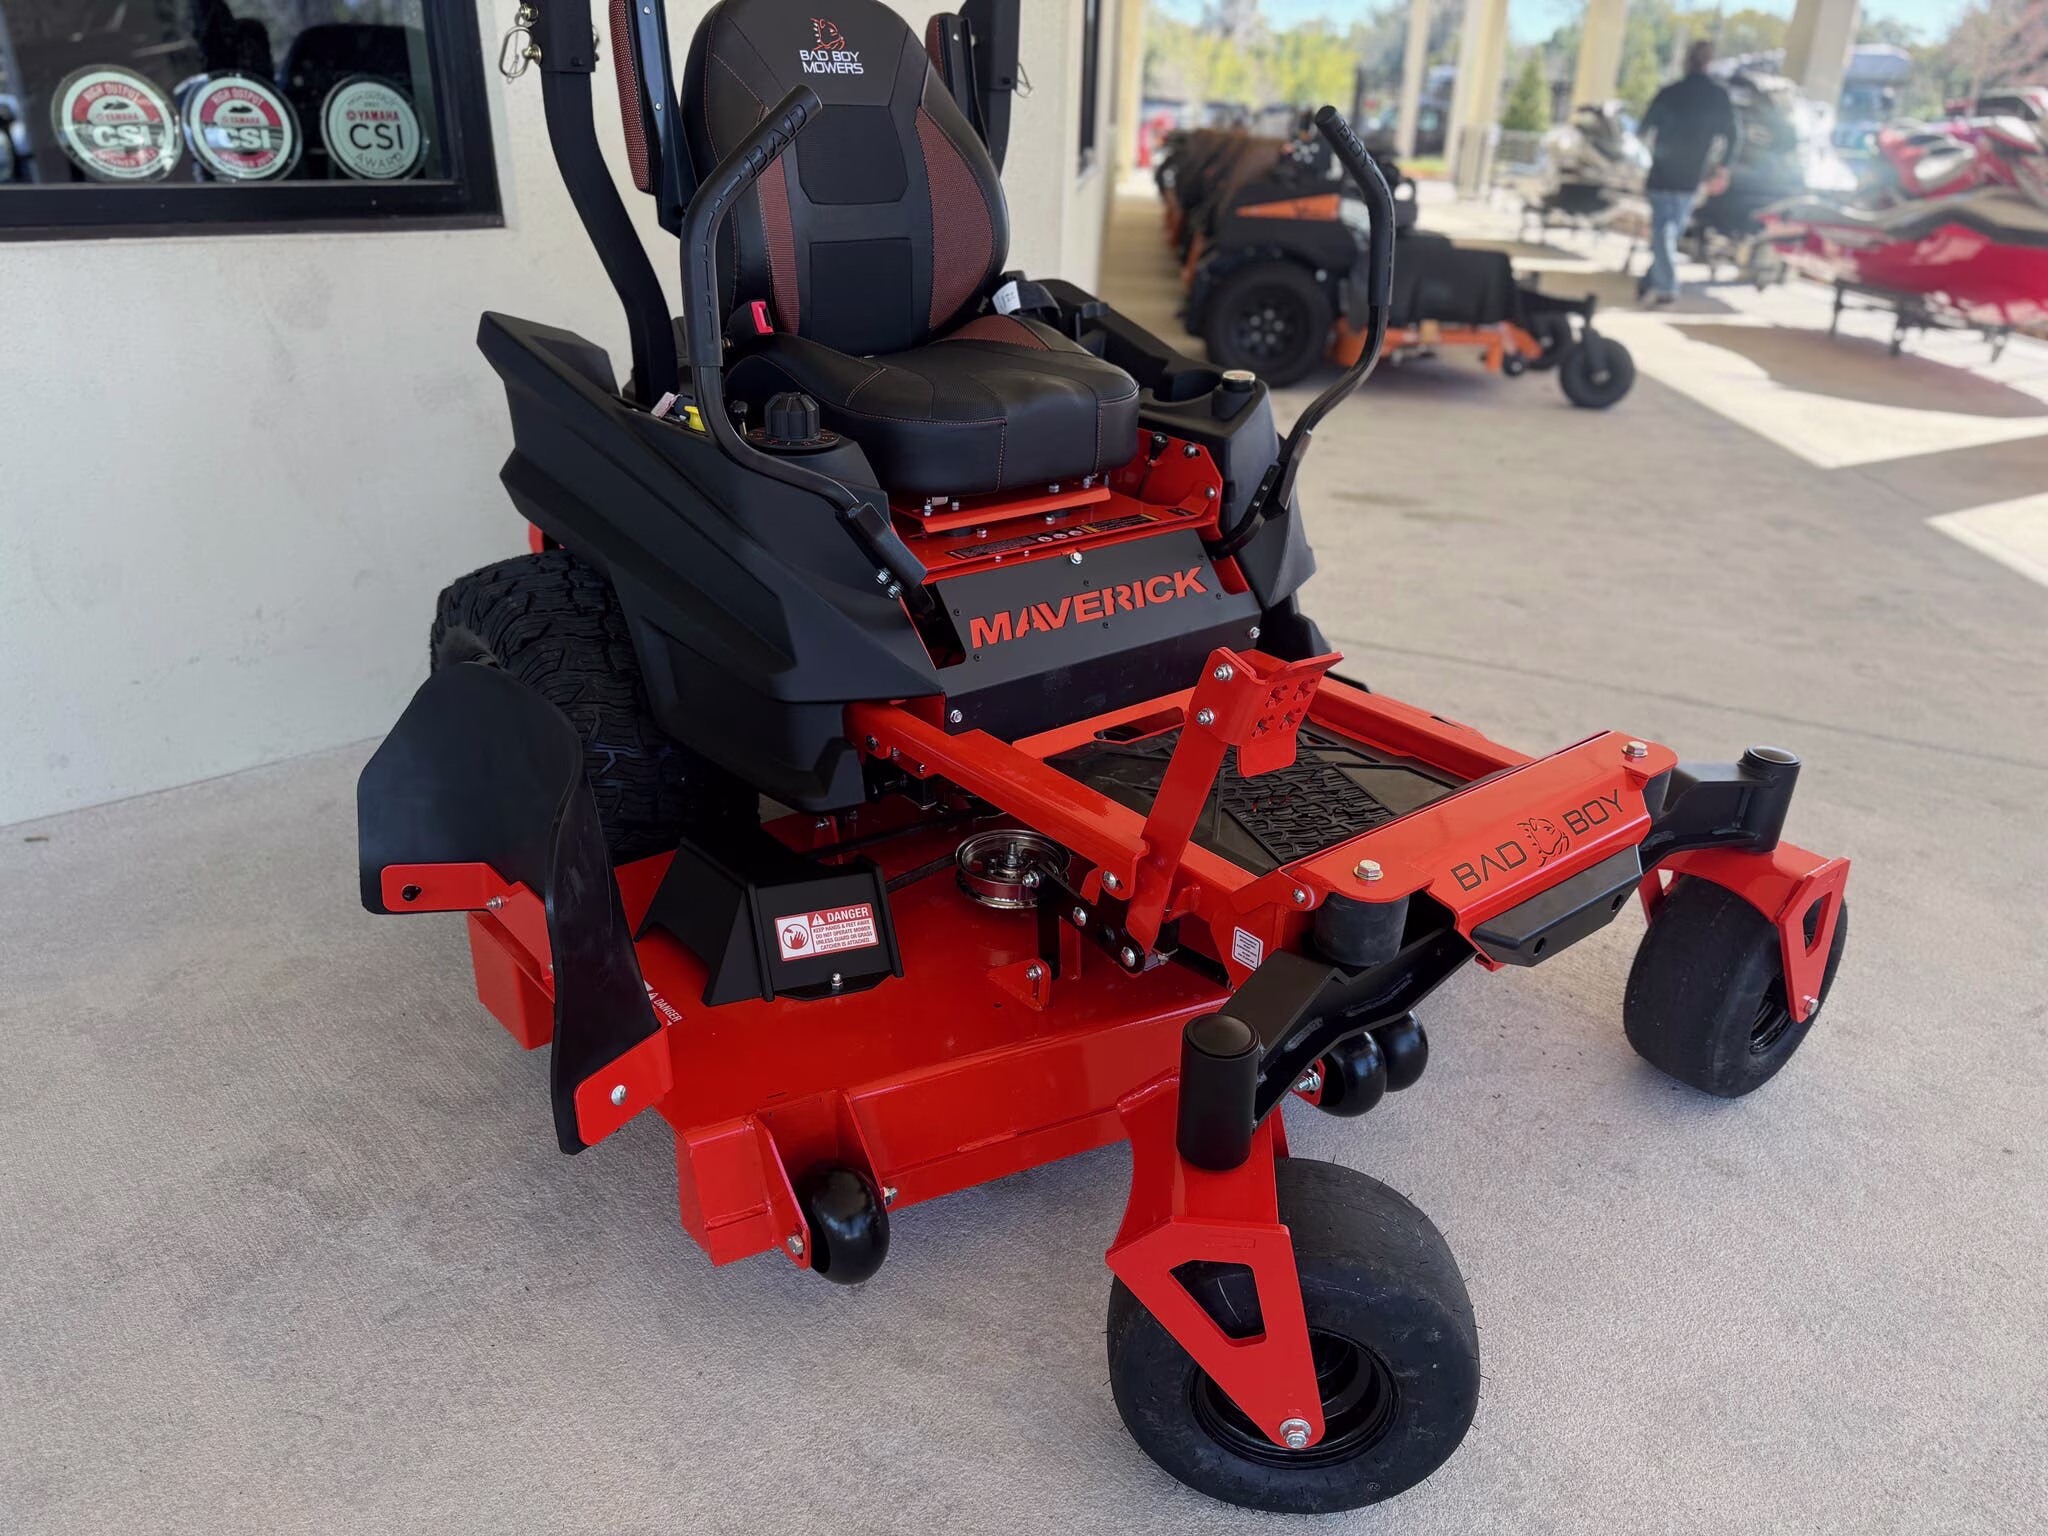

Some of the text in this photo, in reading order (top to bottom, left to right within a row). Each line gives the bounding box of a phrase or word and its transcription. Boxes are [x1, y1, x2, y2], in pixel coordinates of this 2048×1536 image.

[799, 50, 859, 62] BAD BOY
[802, 61, 864, 74] MOWERS
[358, 110, 400, 122] YAMAHA
[93, 125, 152, 147] CSI
[219, 127, 271, 149] CSI
[349, 123, 404, 150] CSI
[744, 104, 807, 178] BAD
[355, 152, 401, 169] AWARD
[969, 566, 1209, 649] MAVERICK
[1451, 789, 1623, 892] BAD BOY
[827, 907, 869, 923] DANGER
[653, 998, 682, 1022] DANGER
